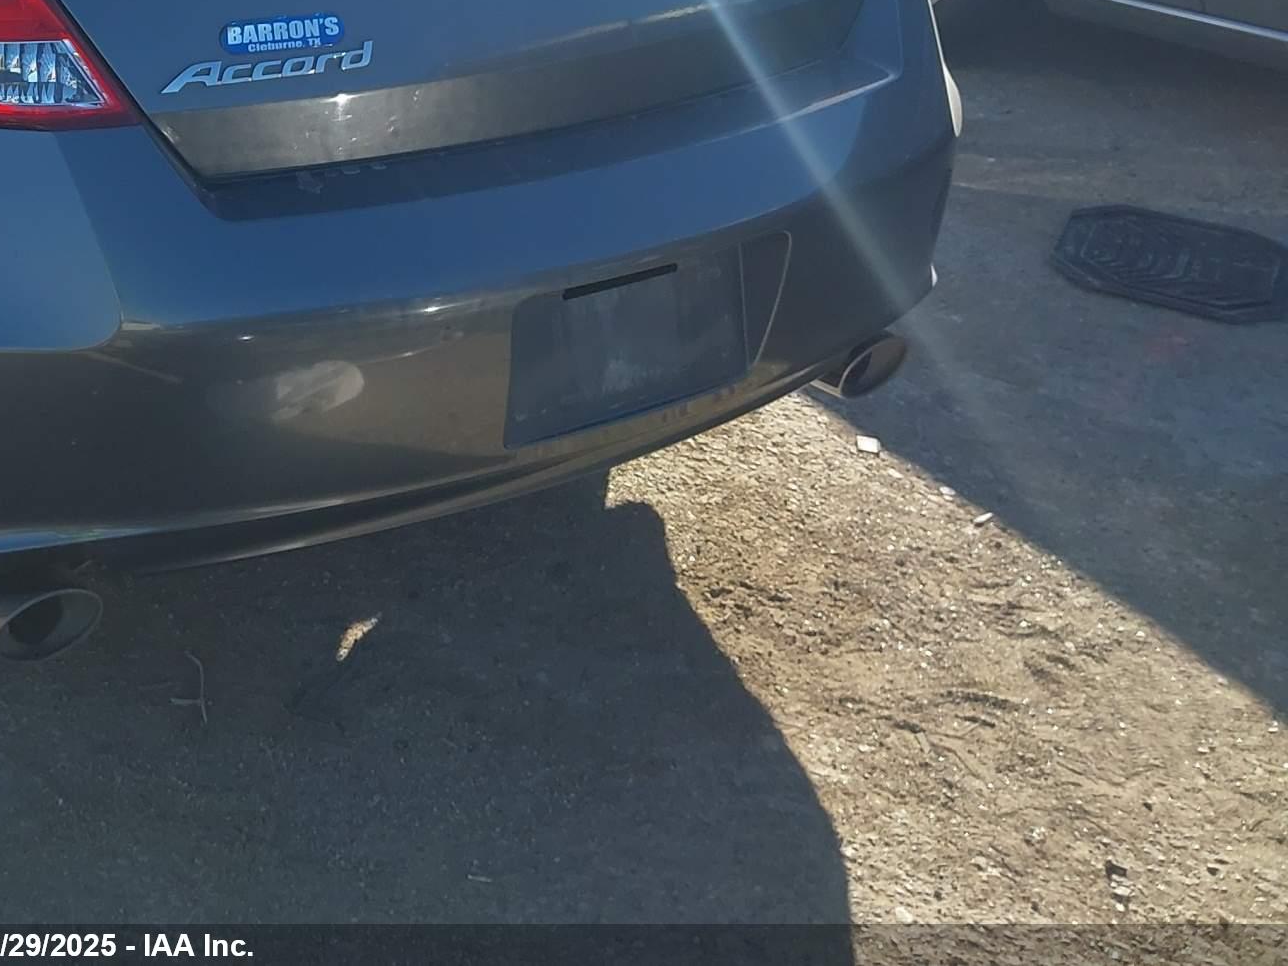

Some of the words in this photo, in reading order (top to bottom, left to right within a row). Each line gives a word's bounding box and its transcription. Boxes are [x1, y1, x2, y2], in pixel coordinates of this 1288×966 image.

[227, 16, 339, 45] BARRON'S
[307, 37, 321, 47] TX
[161, 40, 374, 94] Accord
